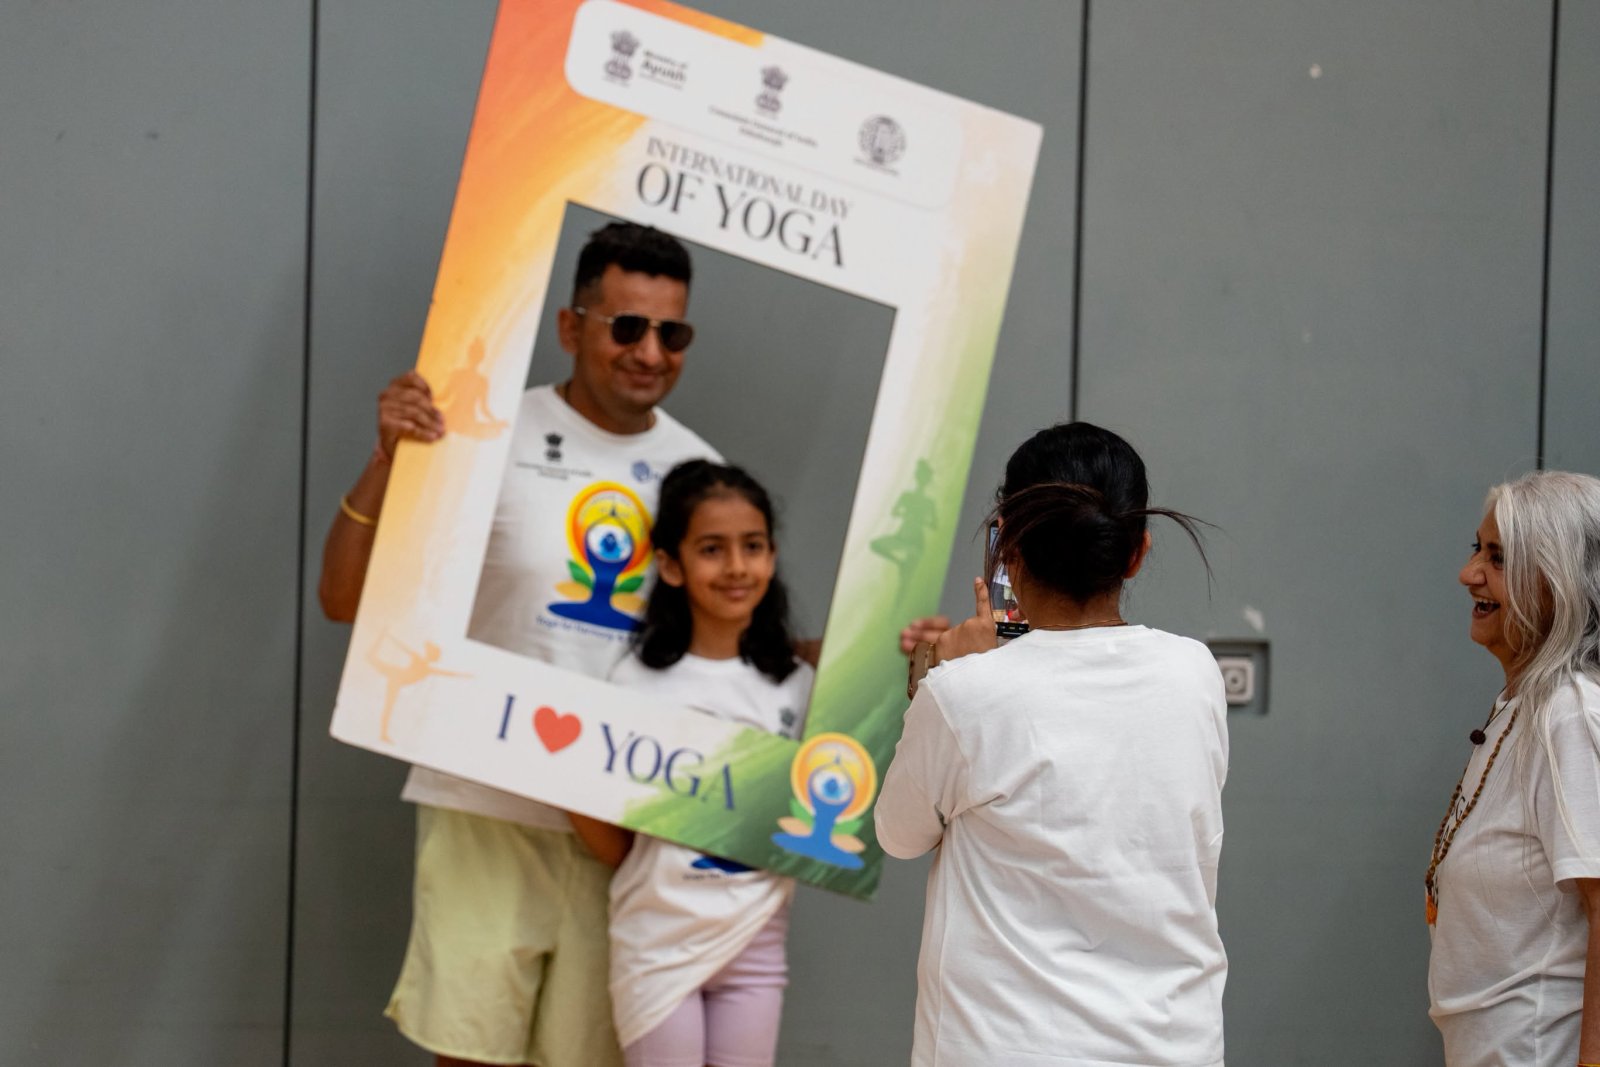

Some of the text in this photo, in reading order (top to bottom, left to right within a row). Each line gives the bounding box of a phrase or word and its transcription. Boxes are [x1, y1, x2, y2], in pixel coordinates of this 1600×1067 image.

[637, 161, 845, 267] OF YOGA
[646, 136, 851, 219] INTERNATIONAL DAY
[496, 692, 735, 811] I YOGA
